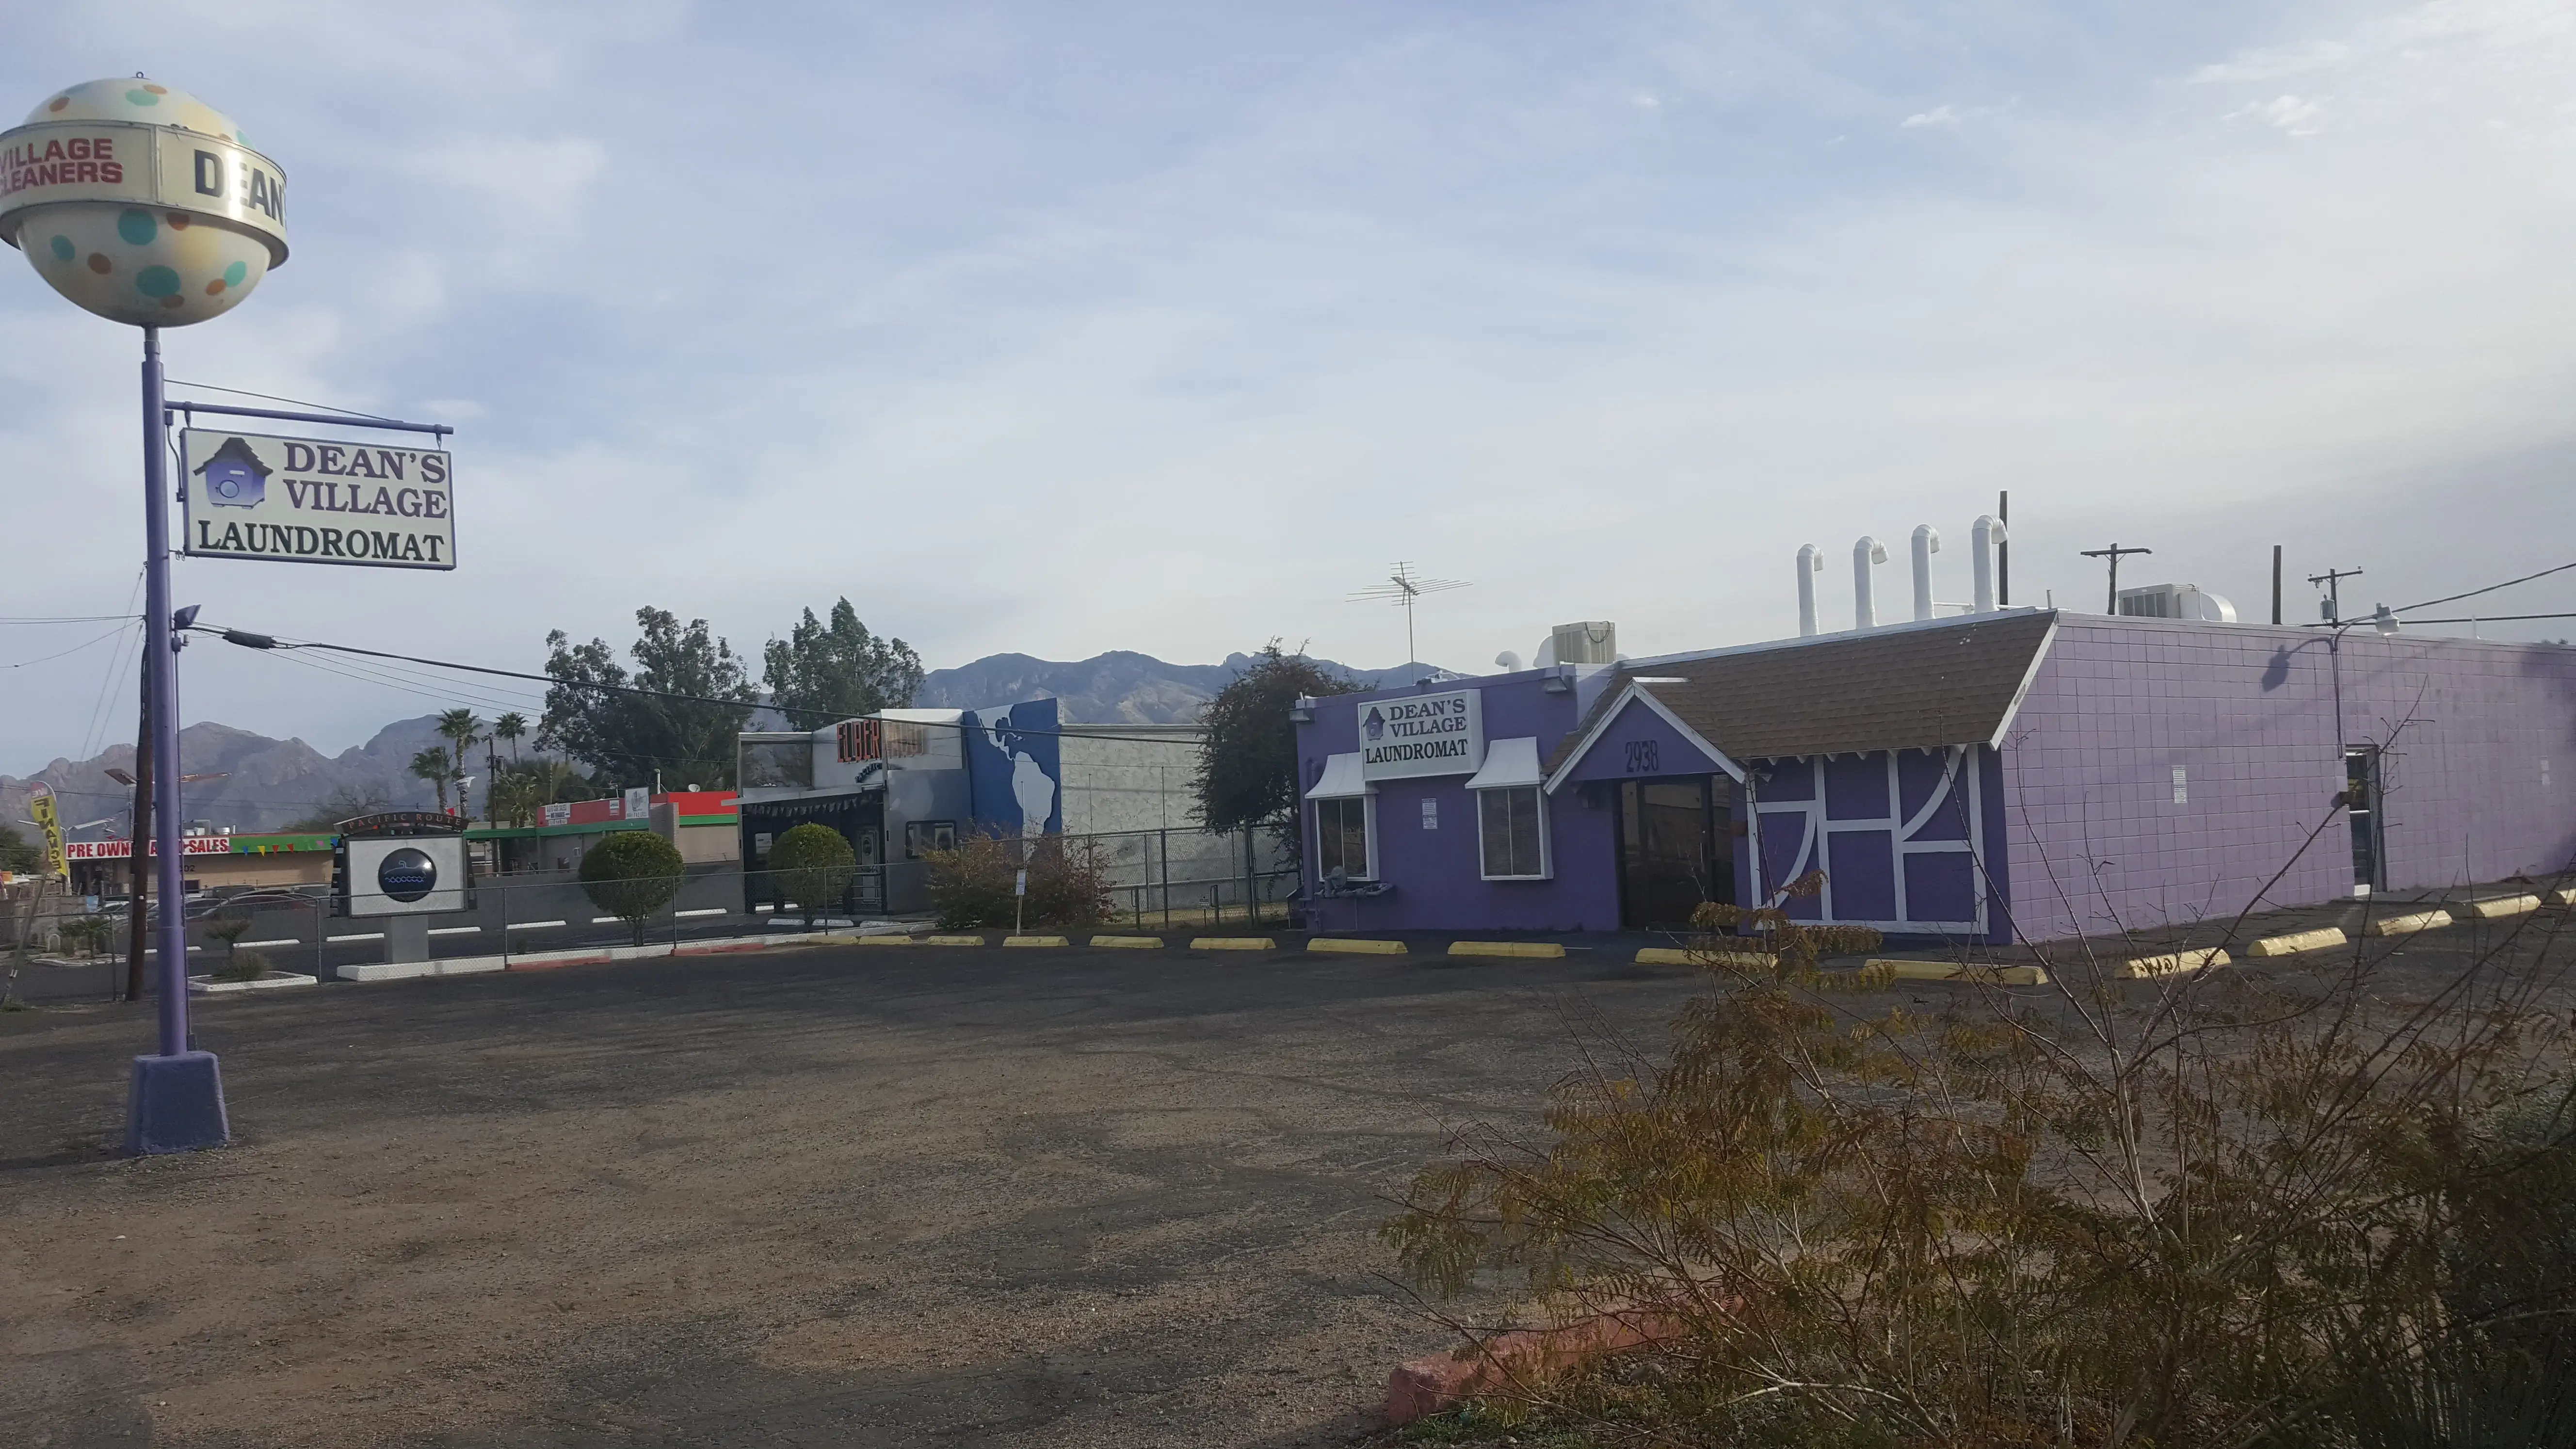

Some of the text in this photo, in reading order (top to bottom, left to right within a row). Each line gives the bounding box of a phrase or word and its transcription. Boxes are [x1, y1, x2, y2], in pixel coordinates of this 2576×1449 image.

[284, 442, 446, 484] DEAN'S
[283, 479, 448, 519] VILLAGE
[198, 520, 445, 563] LAUNDROMAT
[1389, 699, 1465, 721] DEAN'S
[1390, 716, 1467, 738] VILLAGE
[1365, 739, 1468, 764] LAUNDROMAT
[348, 813, 462, 830] PACIFIC ROUTE
[67, 843, 94, 858] PRE
[97, 842, 131, 857] OWN
[189, 838, 229, 853] SALES
